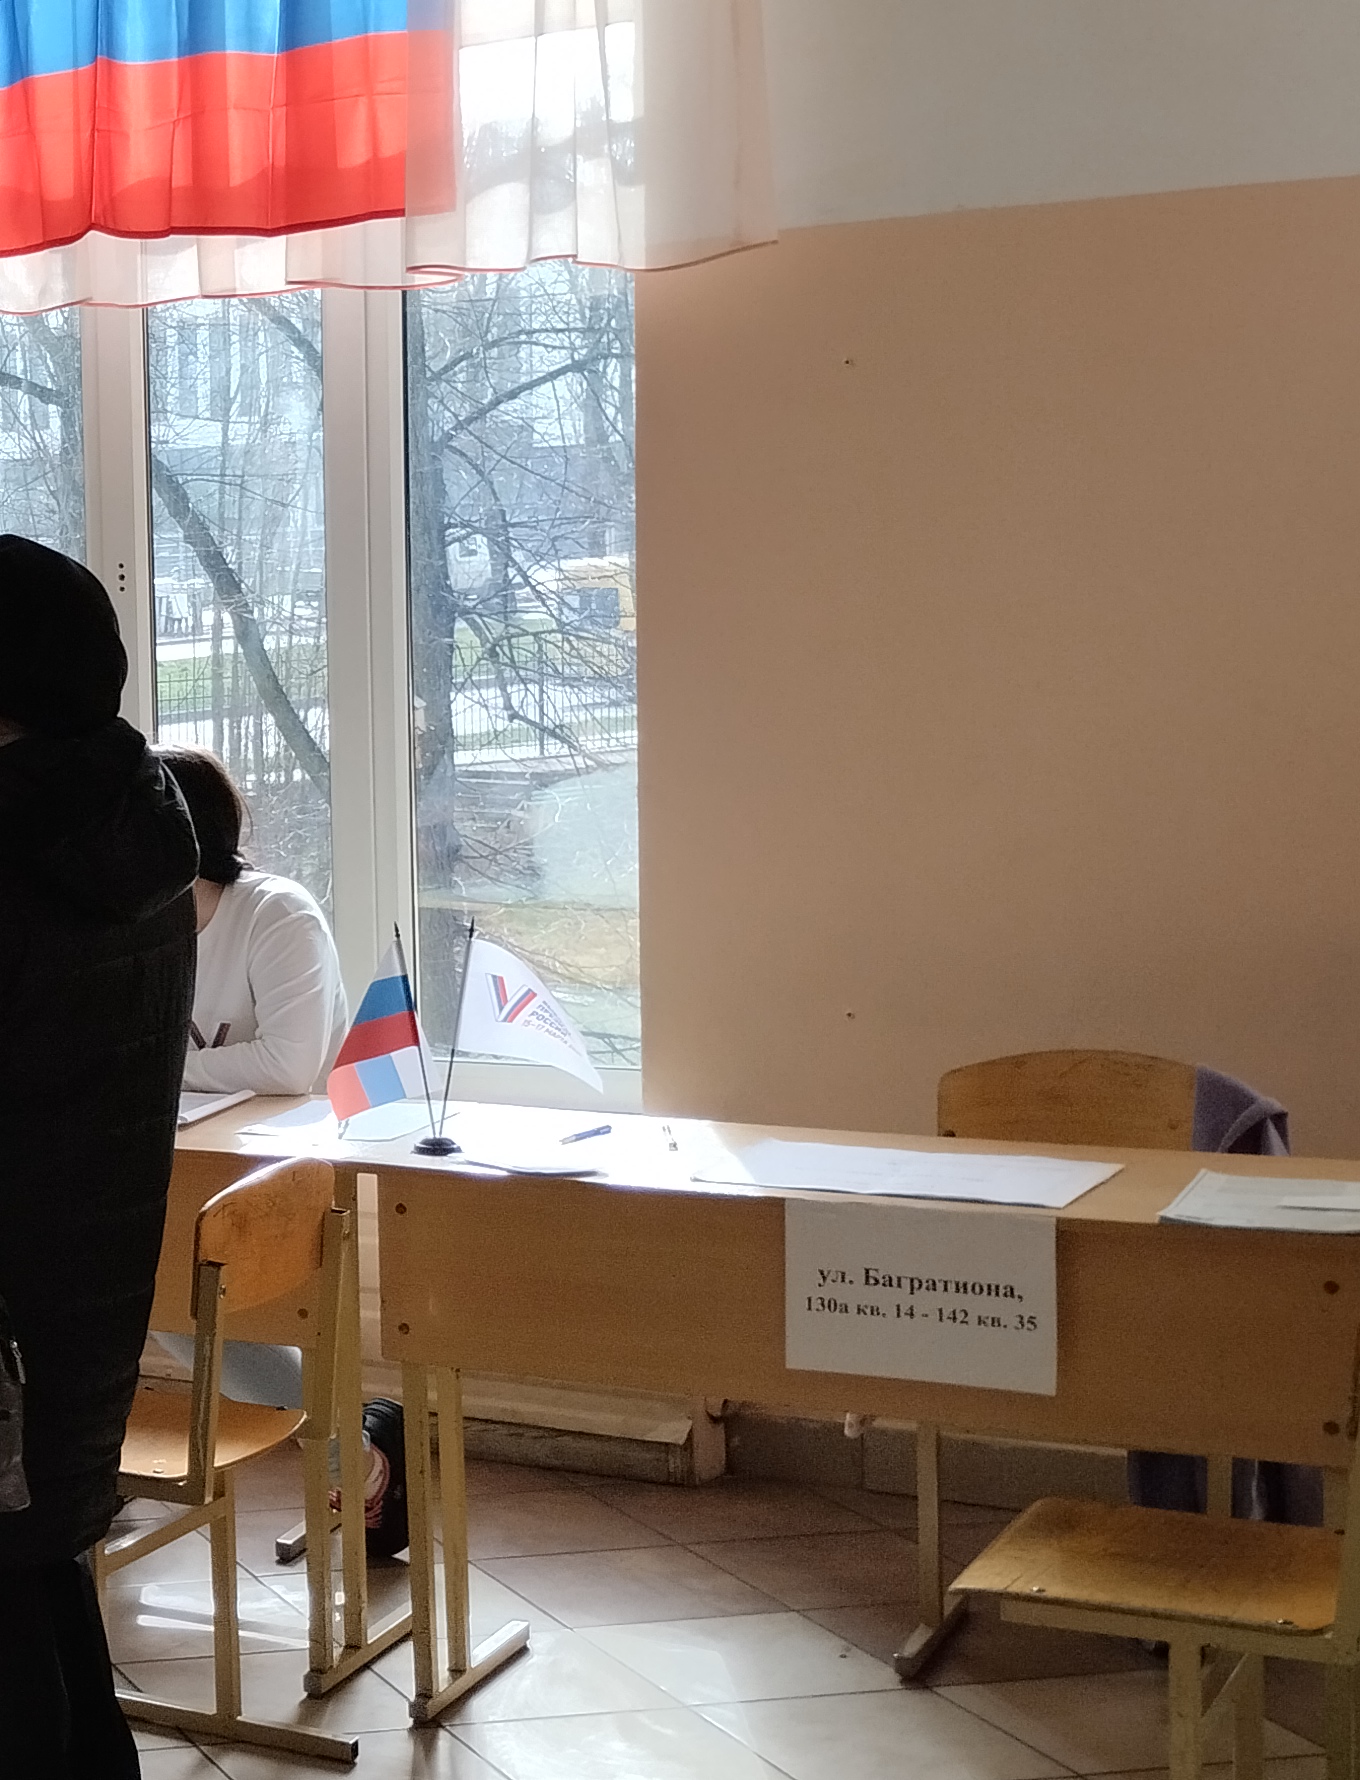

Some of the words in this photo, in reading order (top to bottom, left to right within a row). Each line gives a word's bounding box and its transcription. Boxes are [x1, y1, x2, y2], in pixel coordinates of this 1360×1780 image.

[817, 1267, 855, 1287] ул.
[863, 1266, 1024, 1303] Багратиона,
[805, 1295, 849, 1314] 130а
[856, 1303, 887, 1318] кв.
[895, 1303, 915, 1320] 14
[936, 1306, 969, 1326] 142
[976, 1313, 1008, 1329] кв.
[1014, 1313, 1038, 1332] 35
